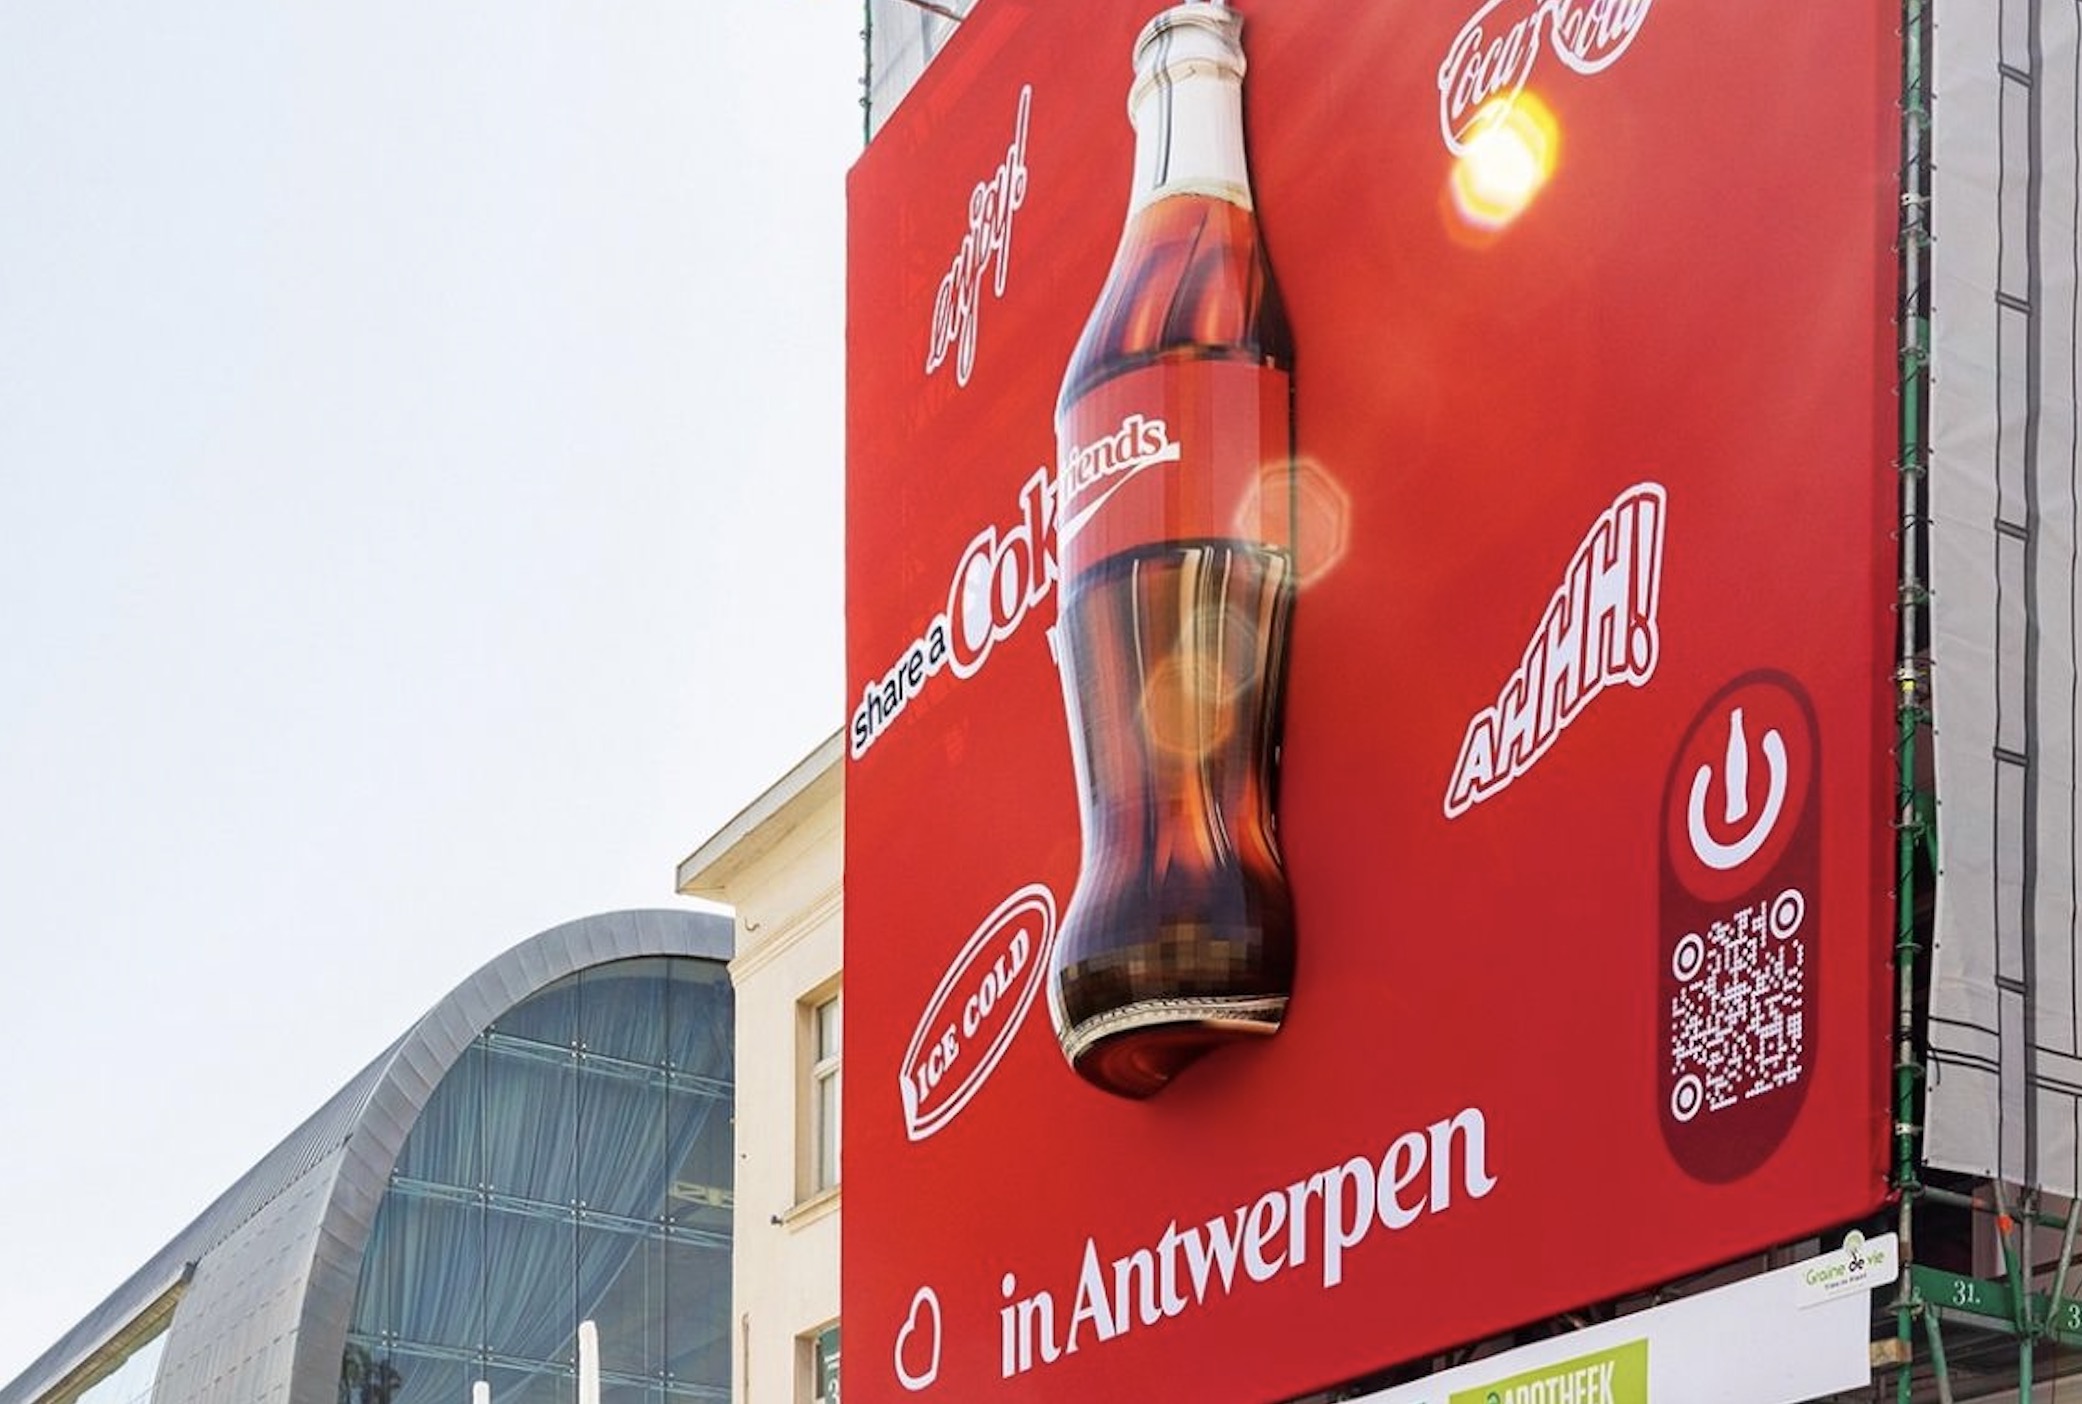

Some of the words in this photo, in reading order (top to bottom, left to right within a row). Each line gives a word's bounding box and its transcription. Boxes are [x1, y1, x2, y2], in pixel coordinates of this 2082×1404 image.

[853, 645, 925, 753] share
[928, 622, 948, 666] a
[948, 466, 1059, 679] Cok
[1444, 482, 1667, 819] AHHH!
[916, 1022, 960, 1104] ICE
[963, 928, 1031, 1039] COLD
[1000, 1272, 1061, 1379] in
[1065, 1107, 1498, 1355] Antwerpen
[1848, 1250, 1865, 1272] de
